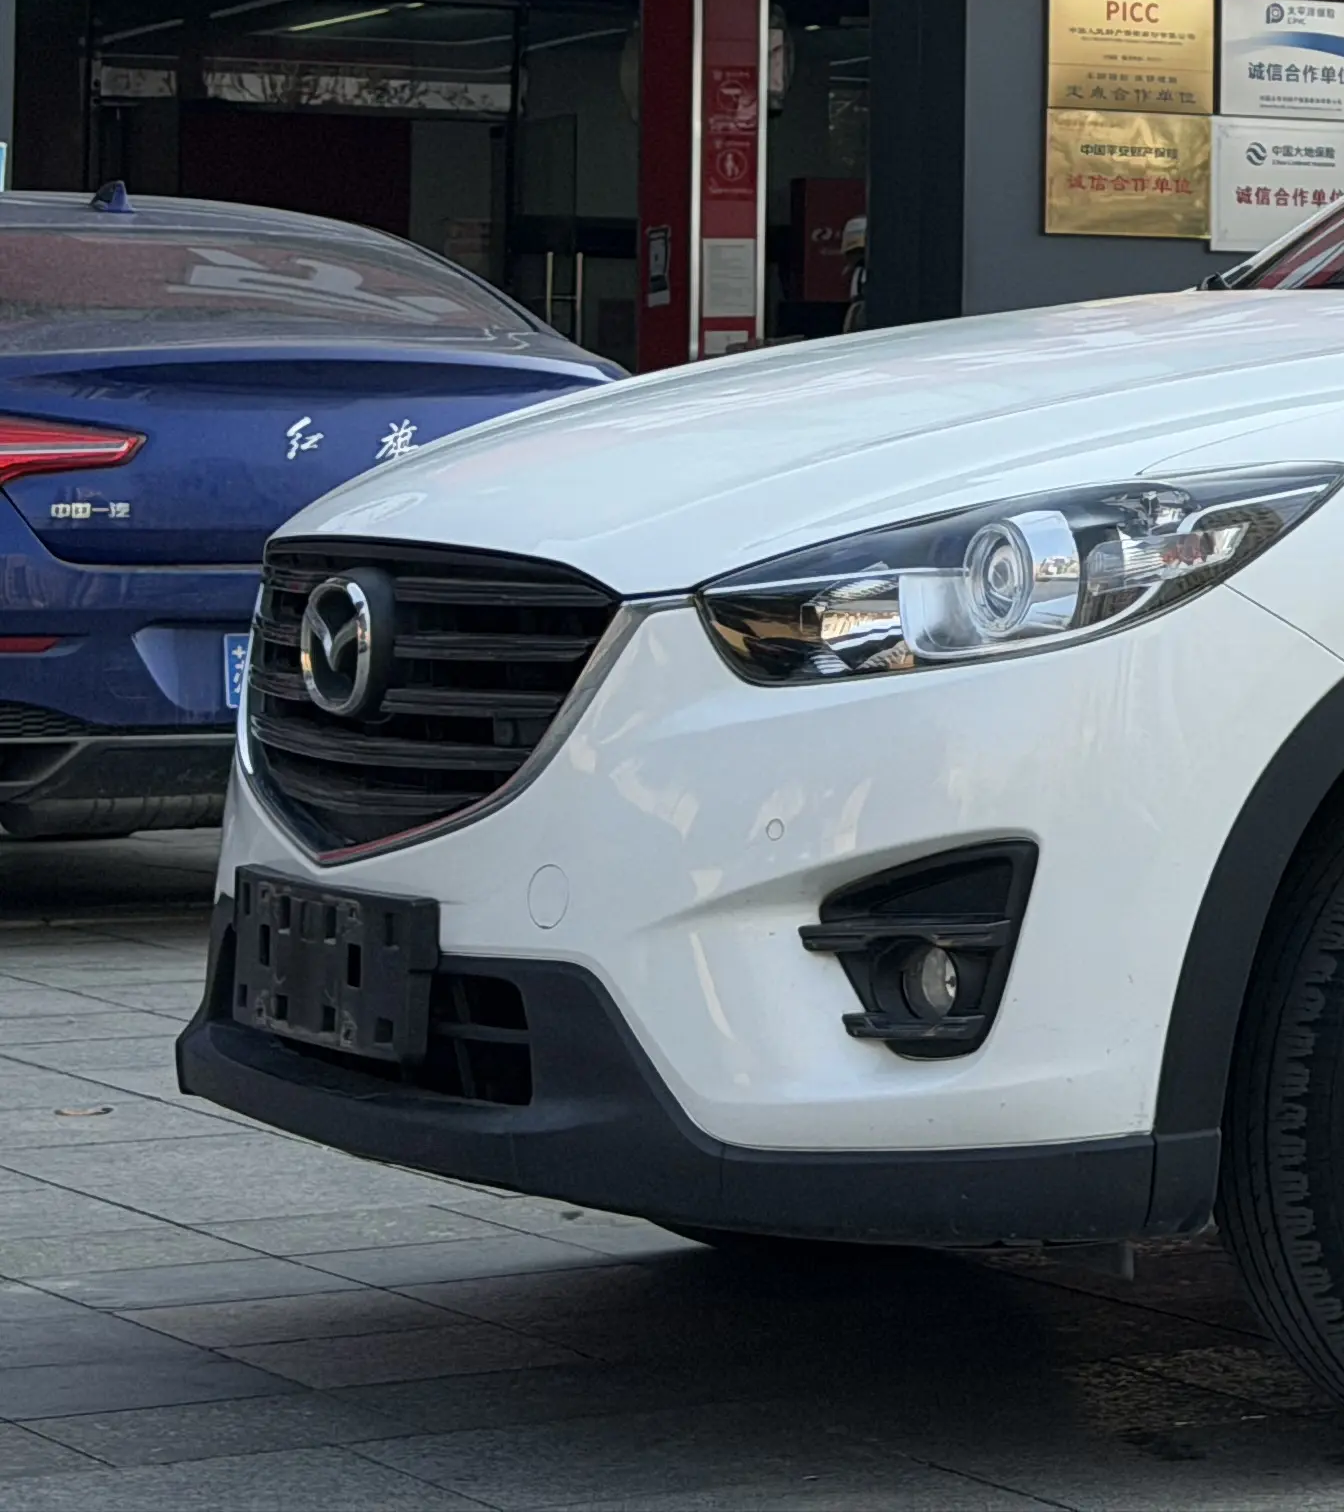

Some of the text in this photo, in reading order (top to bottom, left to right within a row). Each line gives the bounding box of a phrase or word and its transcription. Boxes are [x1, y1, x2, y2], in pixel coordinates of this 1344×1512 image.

[1105, 0, 1161, 25] PICC
[1065, 84, 1198, 105] 定点合作单位
[1080, 143, 1179, 161] 中国平安财产保险
[1271, 144, 1336, 160] 中国大地保险
[1067, 173, 1194, 195] 诚信合作单位
[50, 501, 131, 519] 中国一汽
